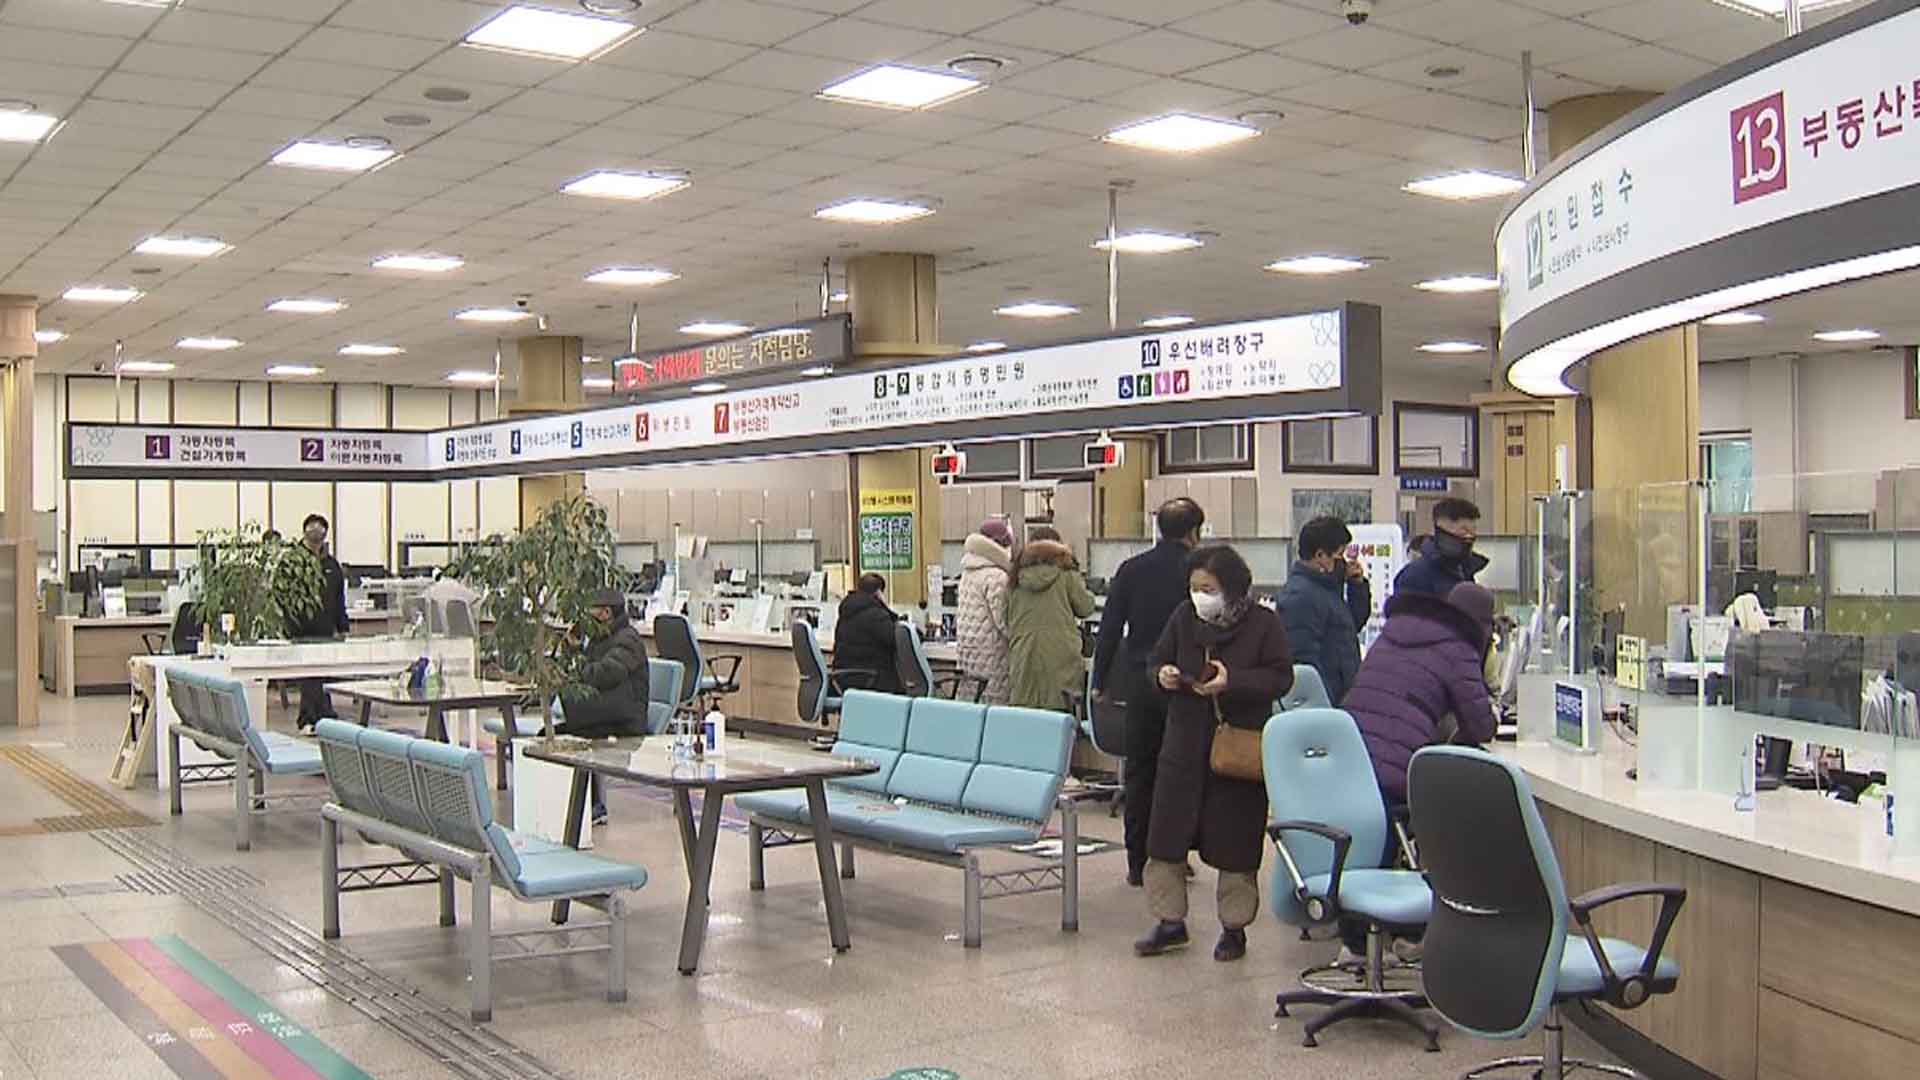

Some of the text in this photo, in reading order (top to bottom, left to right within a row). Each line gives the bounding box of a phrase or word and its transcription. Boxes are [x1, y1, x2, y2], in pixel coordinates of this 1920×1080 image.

[1735, 80, 1920, 189] 13 부동산
[1547, 167, 1633, 241] 민원접수
[704, 343, 746, 374] 문의는
[1142, 340, 1160, 366] 10
